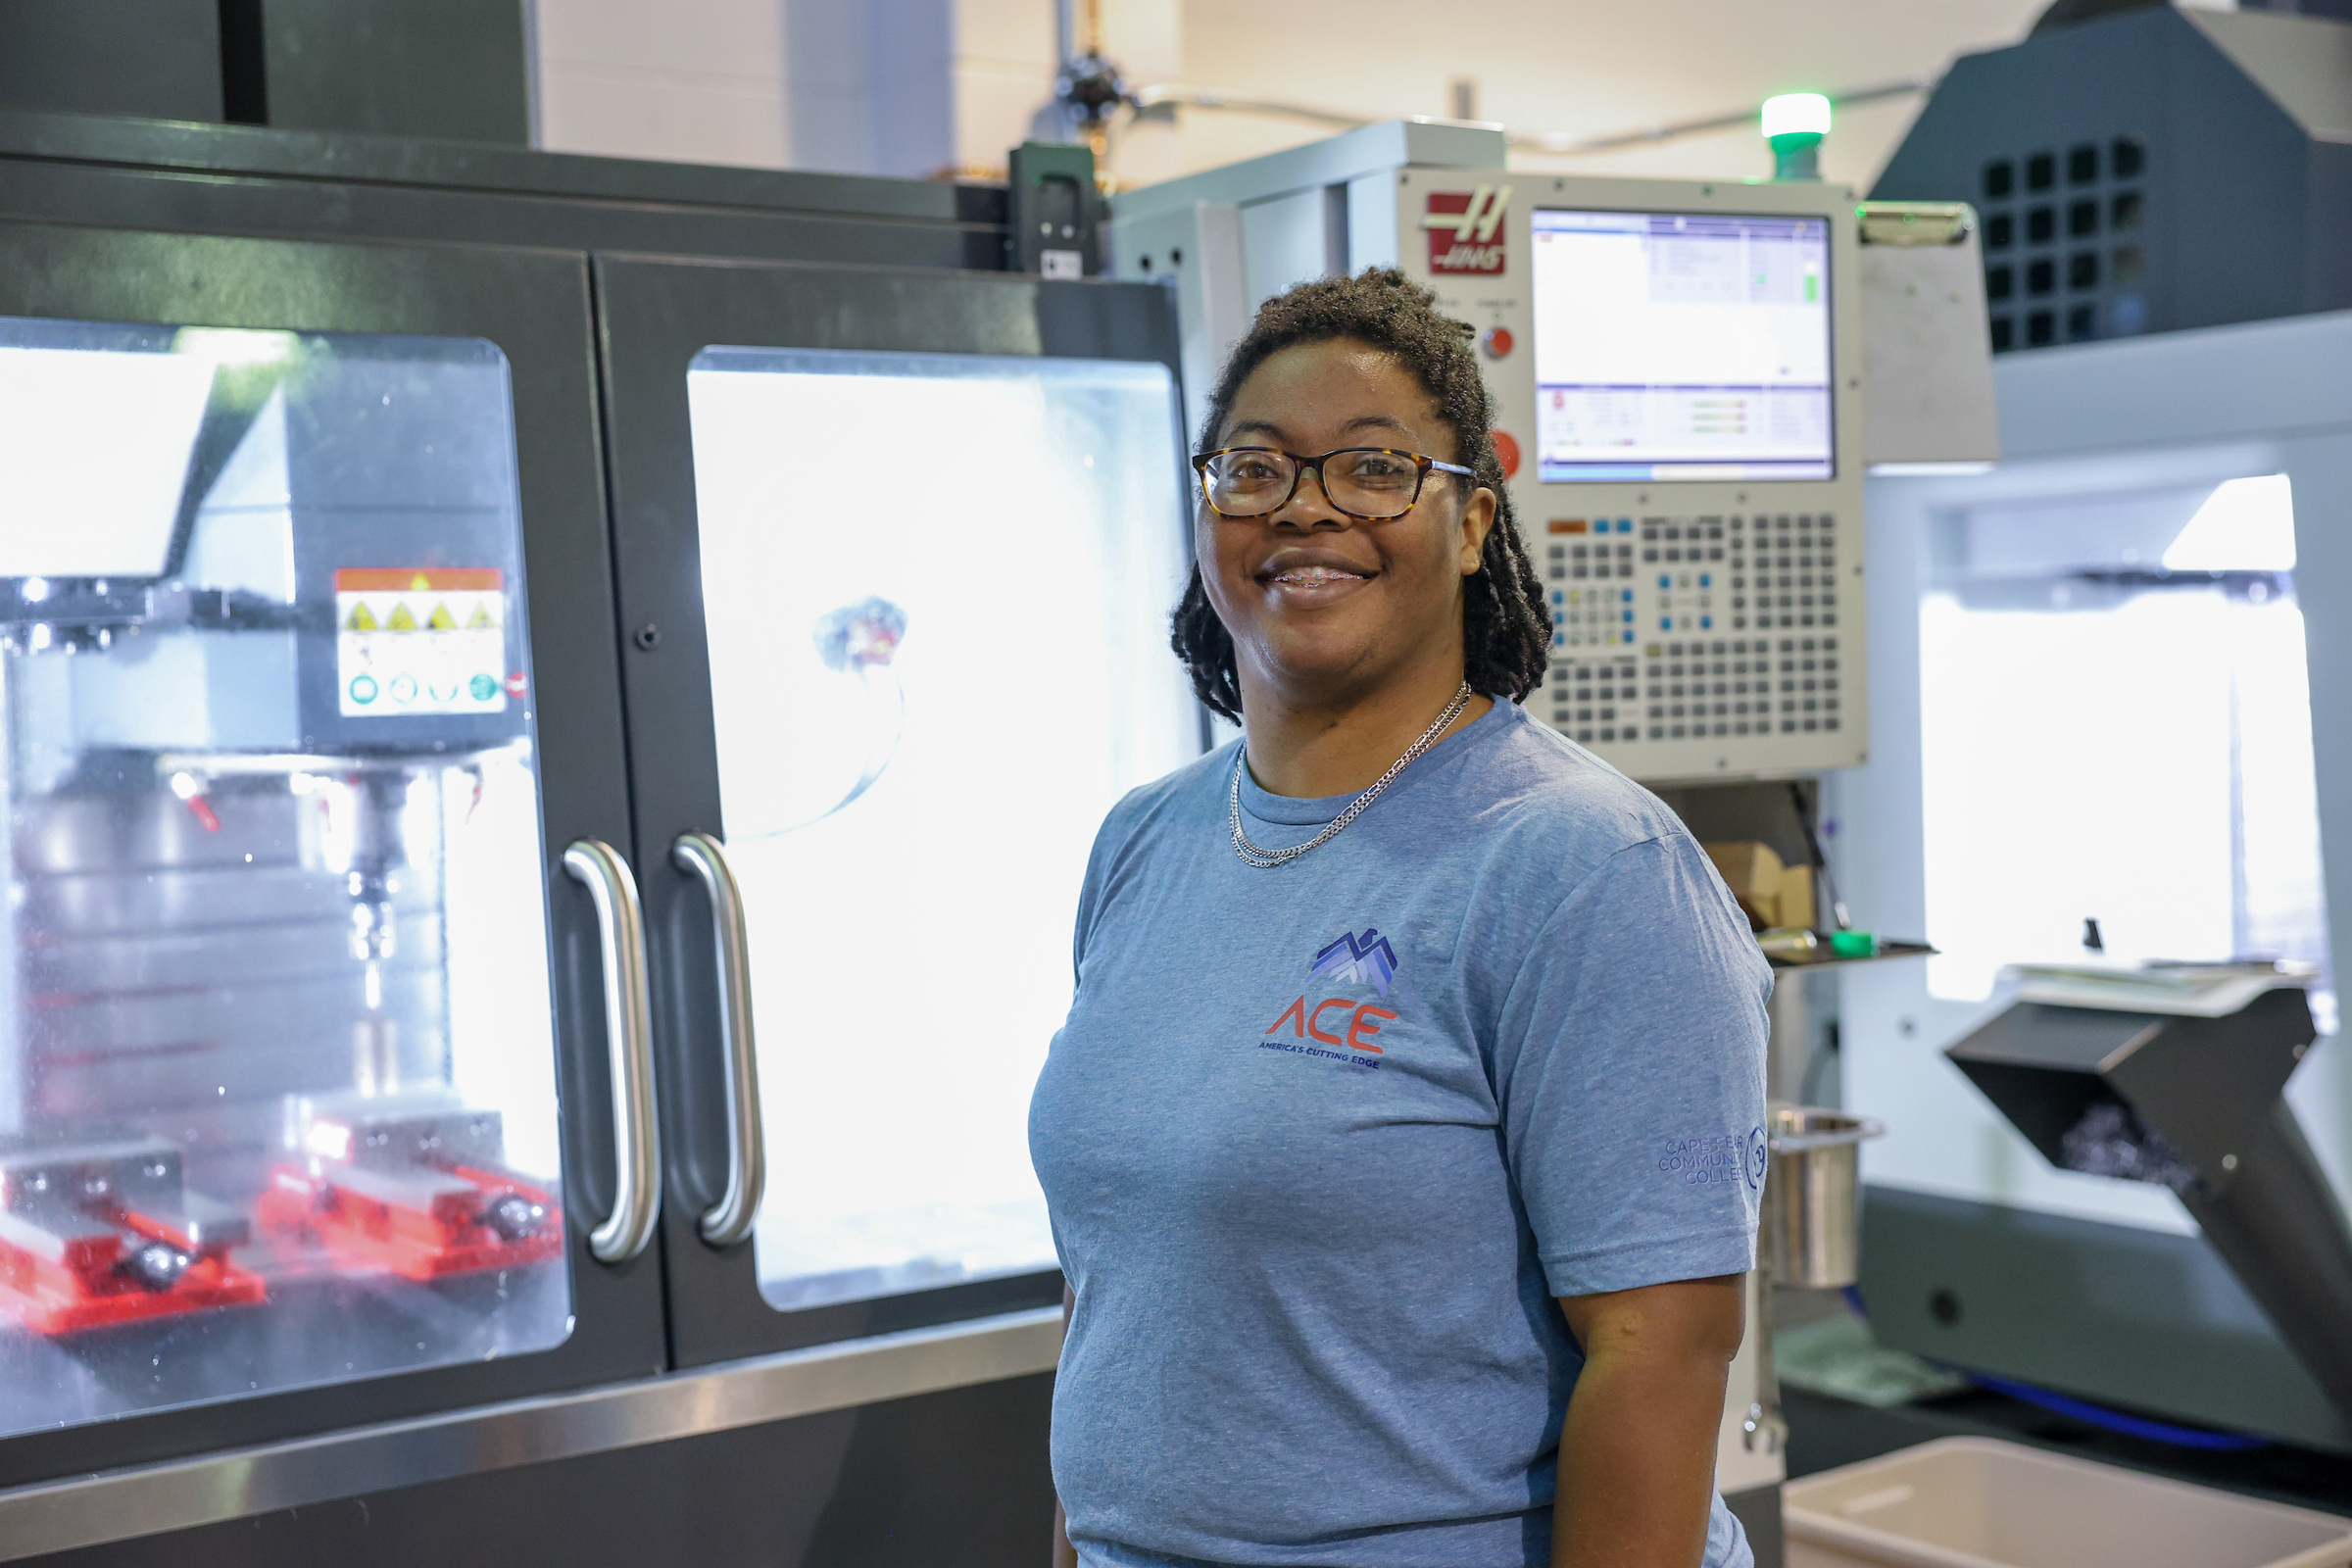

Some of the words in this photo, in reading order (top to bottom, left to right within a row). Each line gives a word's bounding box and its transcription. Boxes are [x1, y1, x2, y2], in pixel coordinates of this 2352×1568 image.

[1265, 995, 1398, 1054] ACE
[1258, 1042, 1304, 1054] AMERICA'S
[1306, 1048, 1348, 1061] CUTTING
[1351, 1055, 1380, 1069] EDGE
[1666, 1138, 1710, 1154] CAPE
[1711, 1135, 1743, 1152] FER
